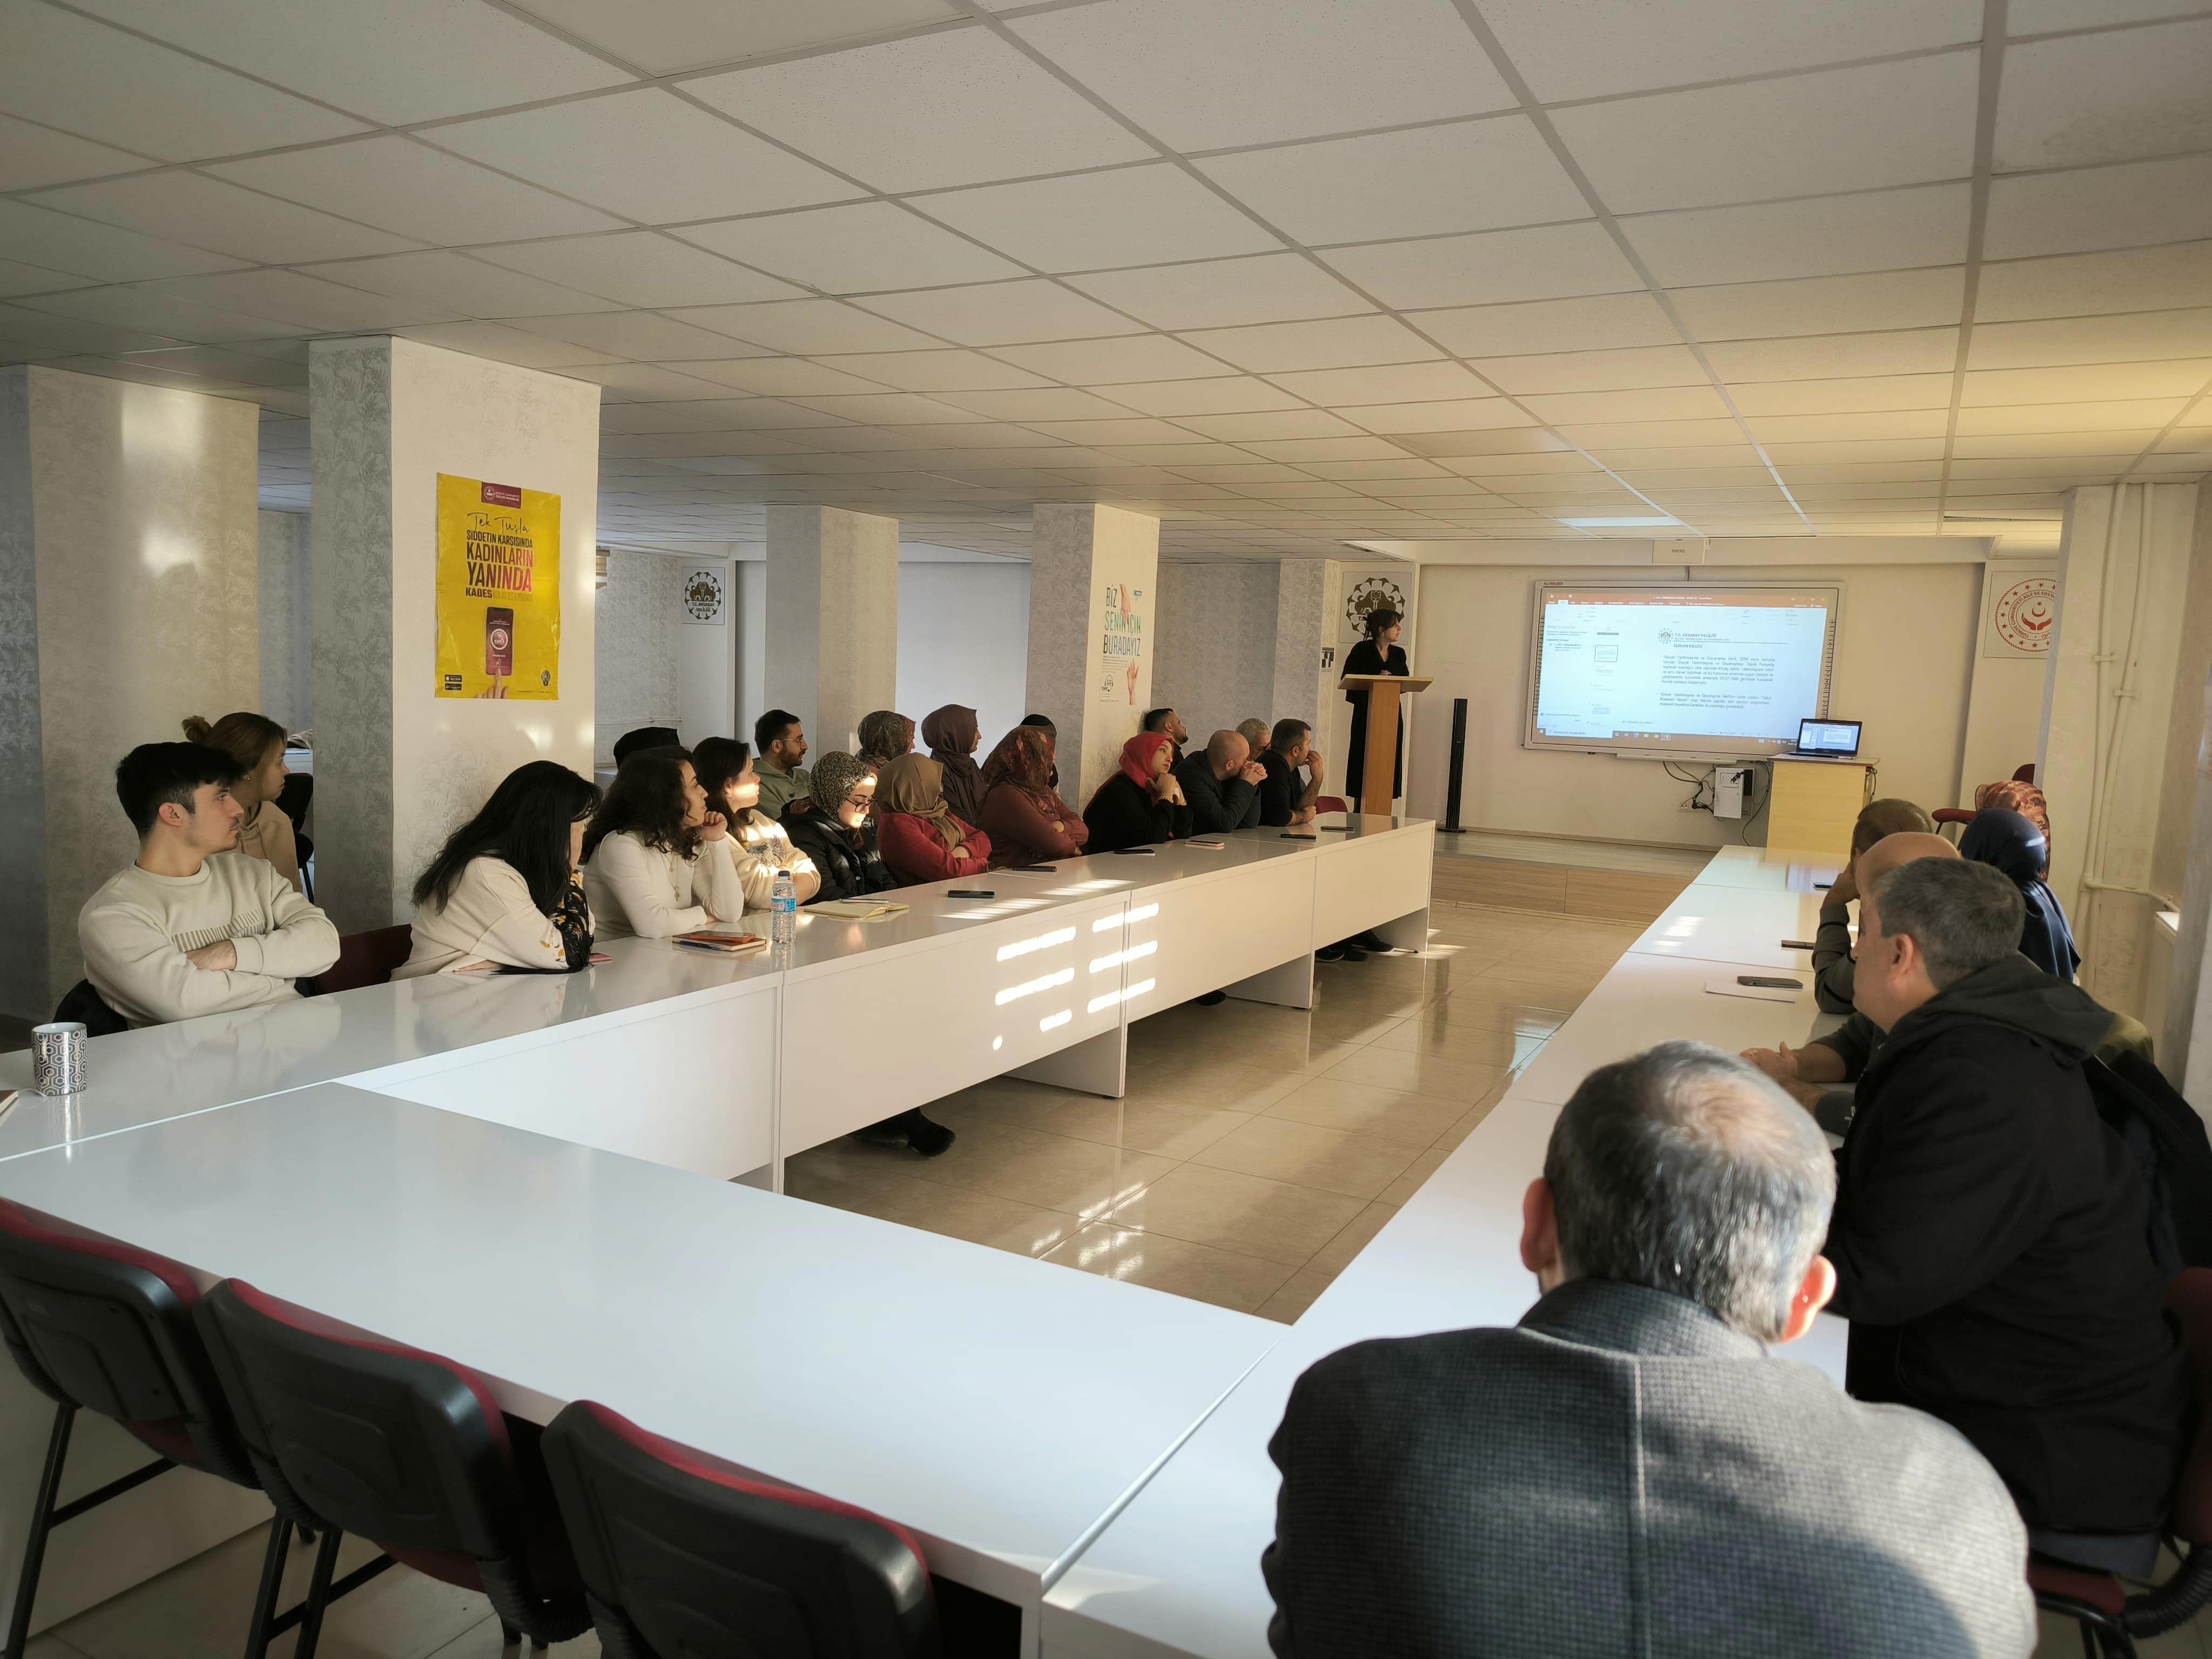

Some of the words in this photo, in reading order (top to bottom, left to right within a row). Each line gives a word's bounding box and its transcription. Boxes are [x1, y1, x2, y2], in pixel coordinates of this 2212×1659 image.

[467, 512, 494, 530] Tek
[467, 541, 533, 568] KADINLARIN
[467, 561, 532, 592] YANINDA
[466, 587, 493, 598] KADES
[1106, 584, 1117, 608] BİZ
[1103, 634, 1141, 657] BURADAYIZ
